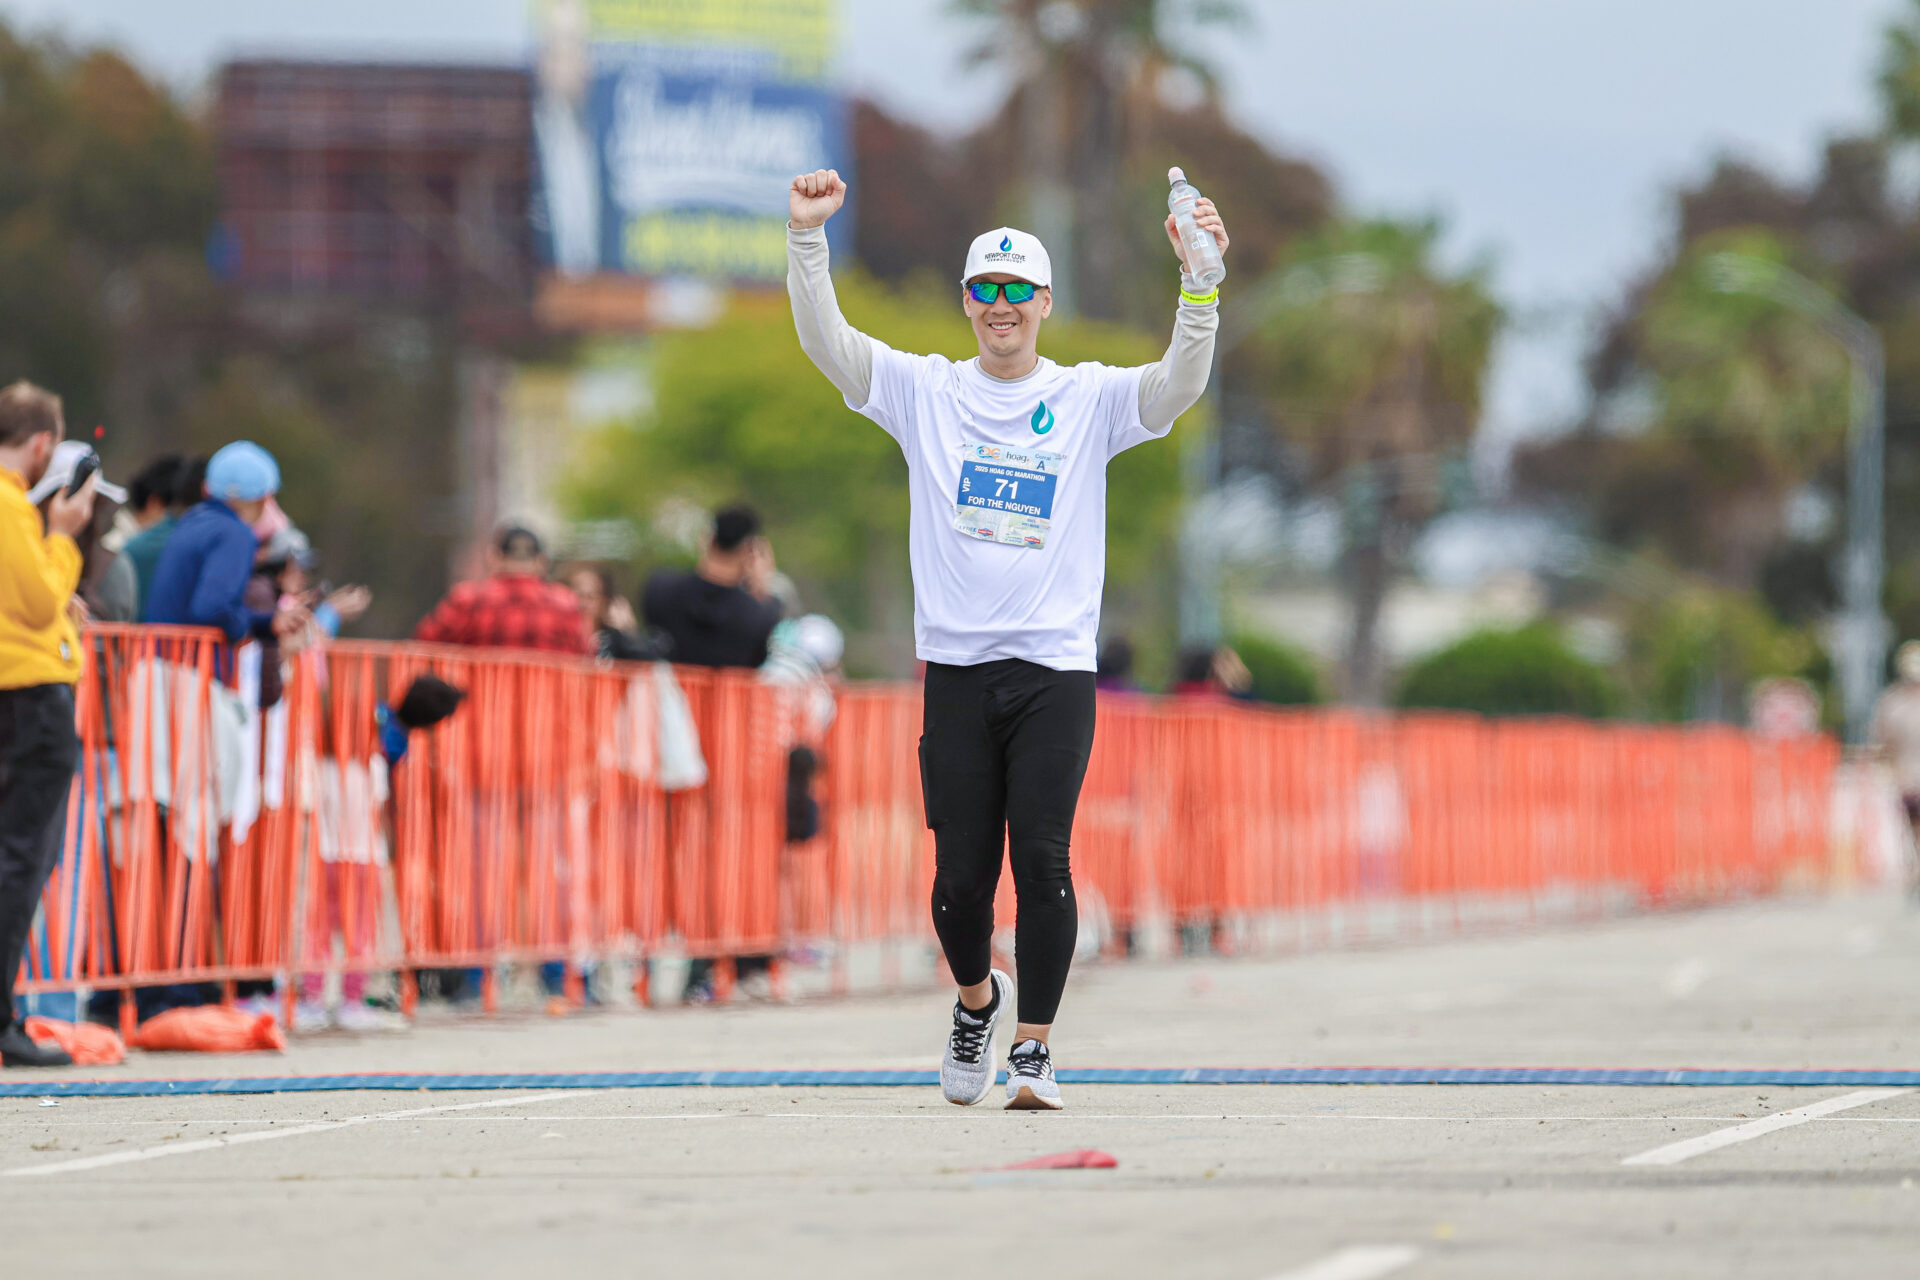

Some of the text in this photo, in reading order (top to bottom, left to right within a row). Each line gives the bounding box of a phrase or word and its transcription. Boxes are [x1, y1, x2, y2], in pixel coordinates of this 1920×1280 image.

[984, 252, 1026, 262] NEWPORT COVE
[1036, 460, 1045, 470] A
[974, 465, 989, 473] 2025
[989, 467, 1005, 475] HOAG
[1014, 472, 1046, 482] MARATHON
[962, 477, 971, 493] VIP
[995, 478, 1019, 500] 71
[967, 495, 1041, 515] FOR THE NGUYEN
